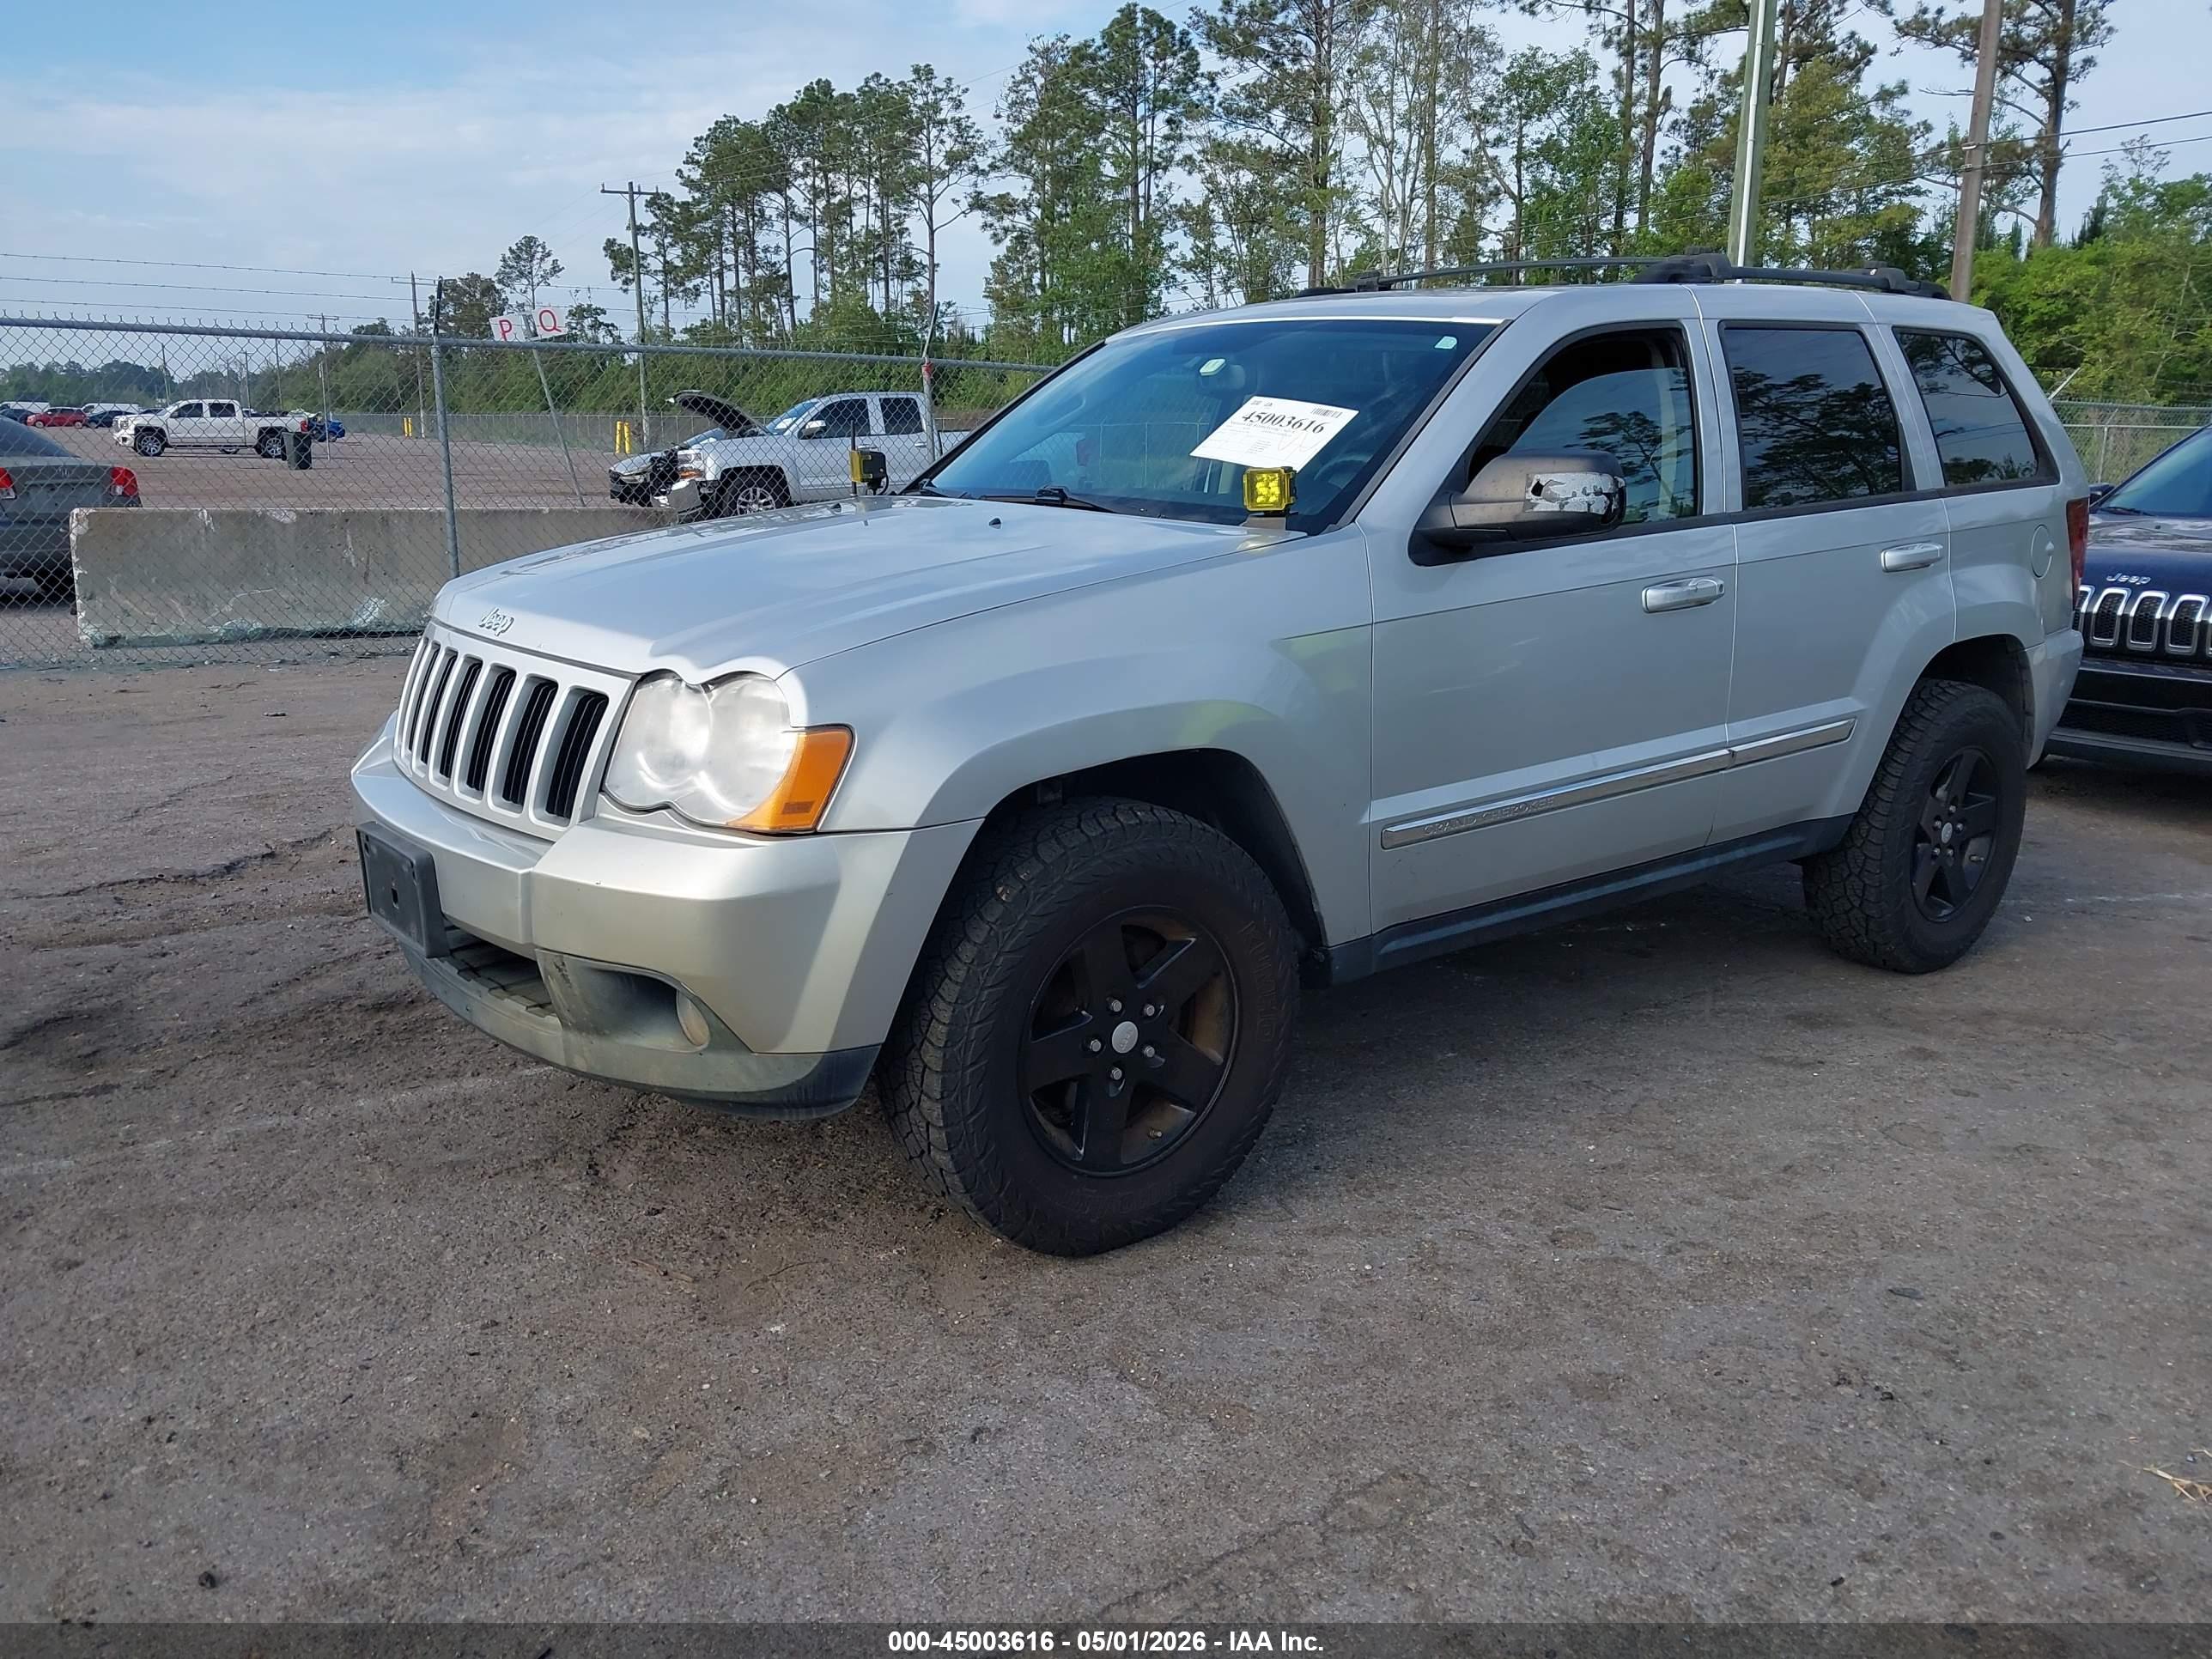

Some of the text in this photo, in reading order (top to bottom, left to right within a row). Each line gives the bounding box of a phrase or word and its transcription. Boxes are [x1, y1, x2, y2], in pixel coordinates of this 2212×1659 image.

[499, 319, 513, 341] P
[538, 309, 562, 333] Q
[1242, 410, 1331, 434] 45003616
[2106, 572, 2152, 586] Jeep
[478, 608, 514, 637] Jeep
[1422, 797, 1555, 836] GRAND CHEROKEE
